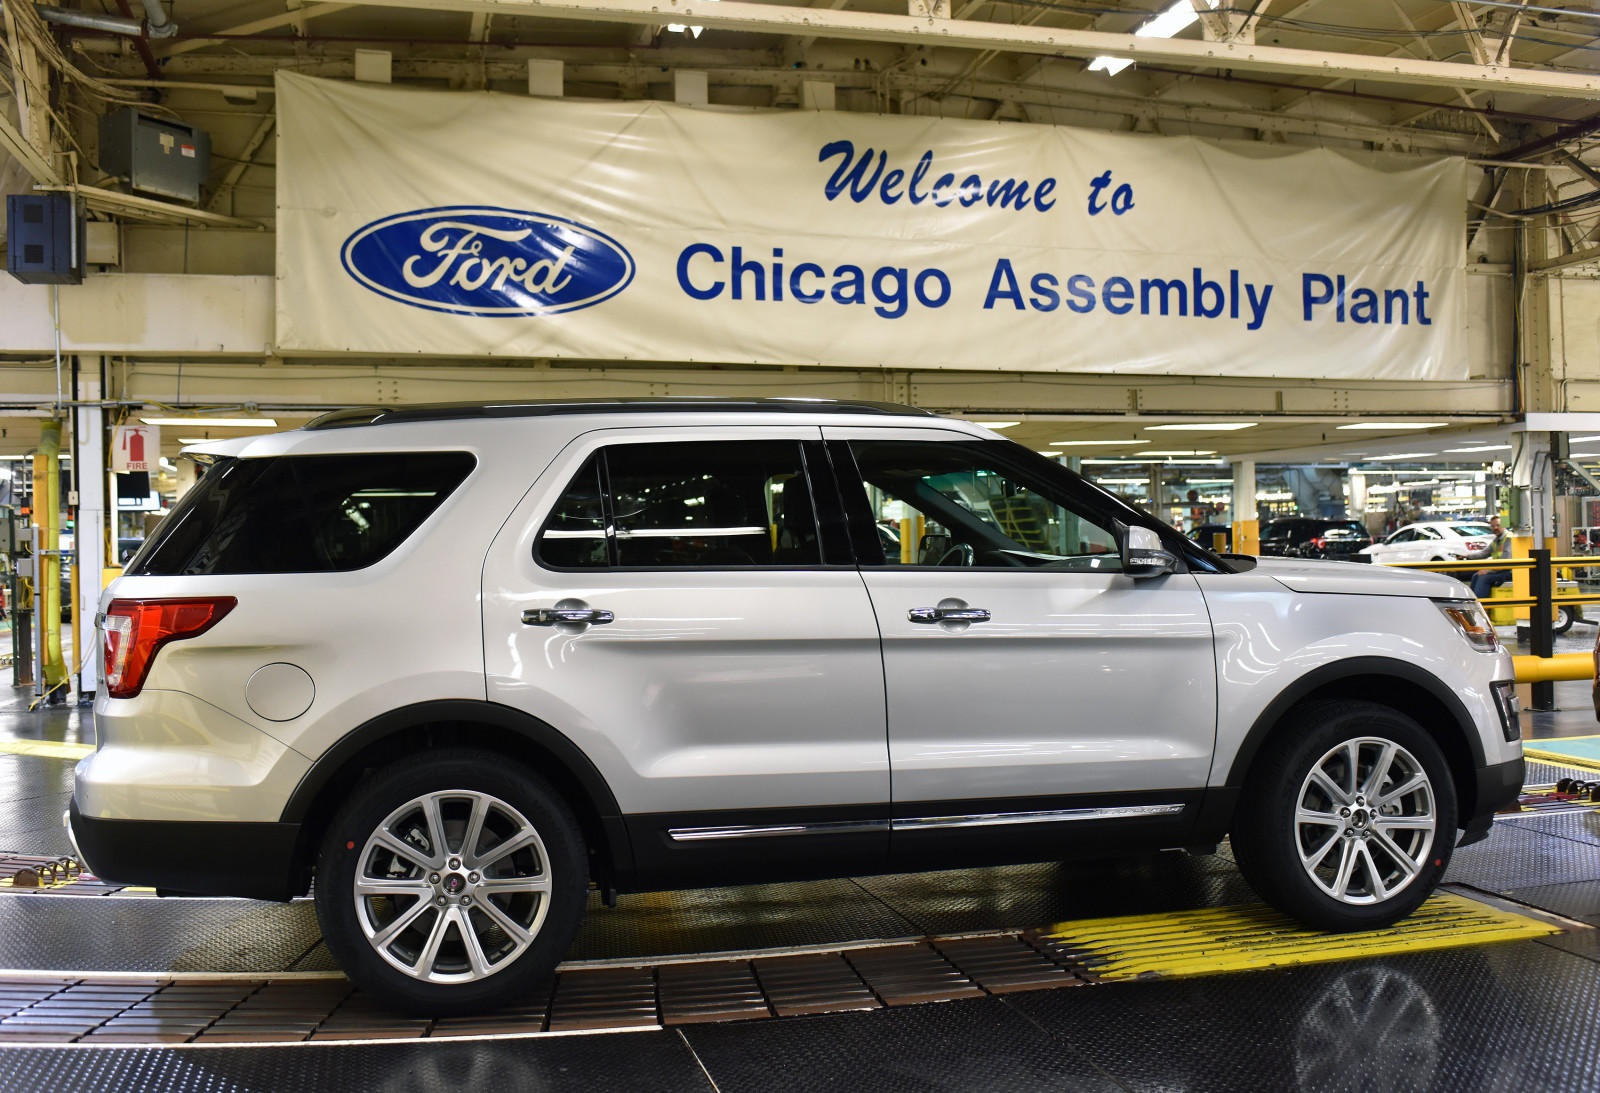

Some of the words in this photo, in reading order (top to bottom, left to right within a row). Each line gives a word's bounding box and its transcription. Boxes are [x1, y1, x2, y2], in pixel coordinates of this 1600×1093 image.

[819, 140, 1057, 213] Welcome
[1088, 170, 1136, 217] to
[402, 221, 576, 295] Ford
[676, 242, 952, 320] Chicago
[983, 258, 1274, 331] Assembly
[1302, 273, 1432, 326] Plant
[126, 462, 149, 470] FIRE
